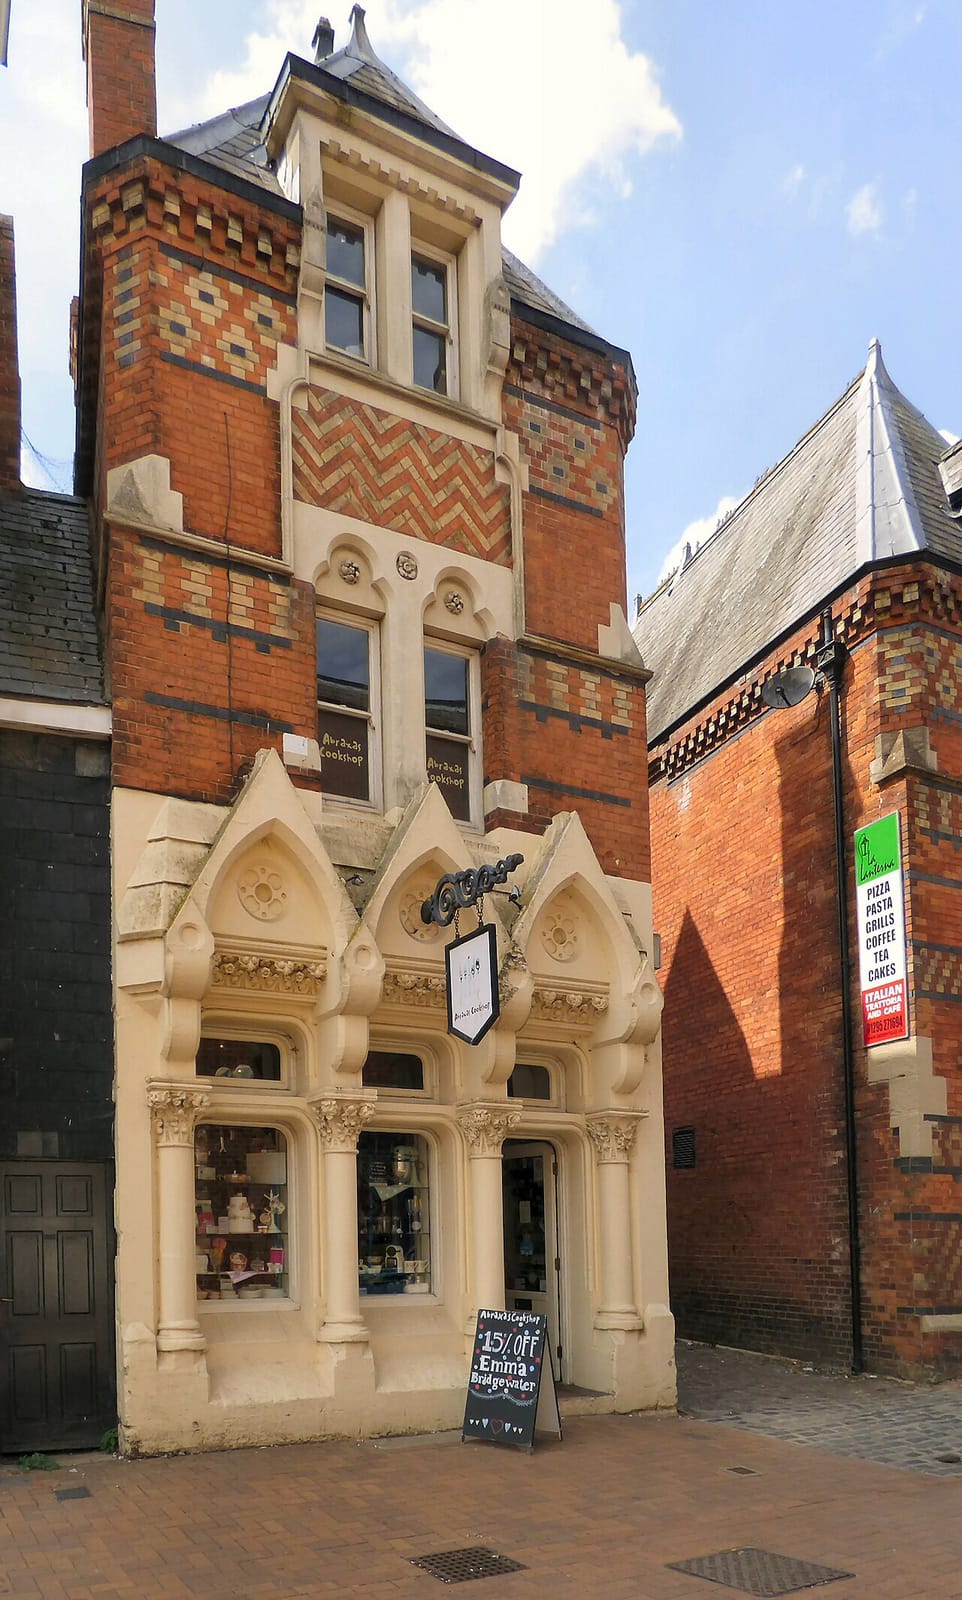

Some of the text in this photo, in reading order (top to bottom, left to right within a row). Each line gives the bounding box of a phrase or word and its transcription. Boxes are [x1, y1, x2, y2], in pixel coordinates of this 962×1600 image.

[323, 733, 362, 751] Abraxas
[320, 747, 364, 767] Cookshop
[427, 757, 463, 775] Abraxas
[860, 859, 895, 882] Lanterna
[866, 880, 891, 901] PIZZA
[866, 896, 893, 918] PASTA
[865, 912, 895, 934] GRILLS
[865, 929, 896, 950] COFFEE
[873, 948, 889, 965] TEA
[868, 963, 896, 982] CAKES
[865, 983, 903, 1004] ITALIAN
[865, 995, 903, 1012] TRATTORIA
[867, 1010, 882, 1020] AND
[480, 1310, 541, 1325] Abraxas Cookshop
[481, 1331, 540, 1358] 15% OFF
[479, 1355, 527, 1377] Emma
[470, 1372, 536, 1392] Bridgewater
